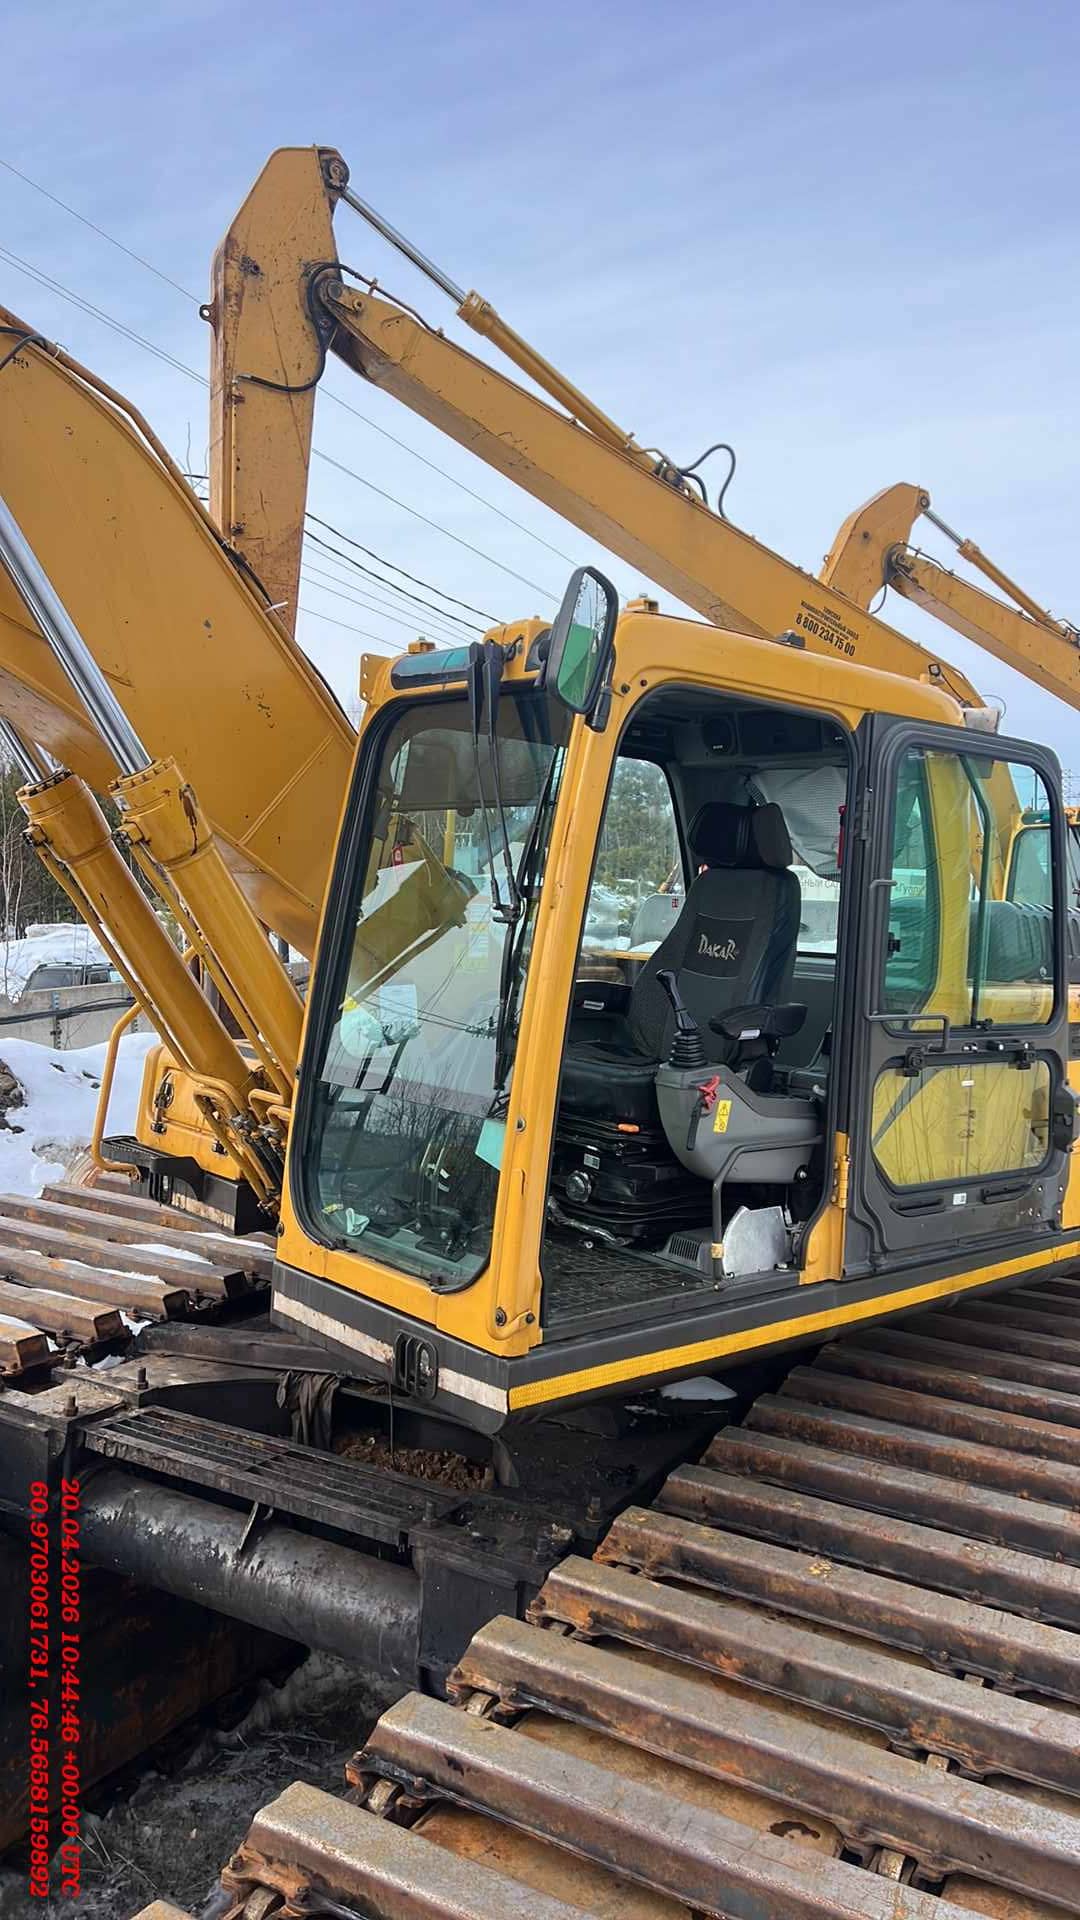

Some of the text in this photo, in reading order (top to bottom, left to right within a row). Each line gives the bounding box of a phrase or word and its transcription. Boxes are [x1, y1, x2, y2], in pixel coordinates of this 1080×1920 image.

[796, 613, 802, 625] 8
[803, 617, 818, 634] 800
[818, 627, 835, 644] 234
[834, 636, 844, 650] 75
[844, 642, 856, 656] 00
